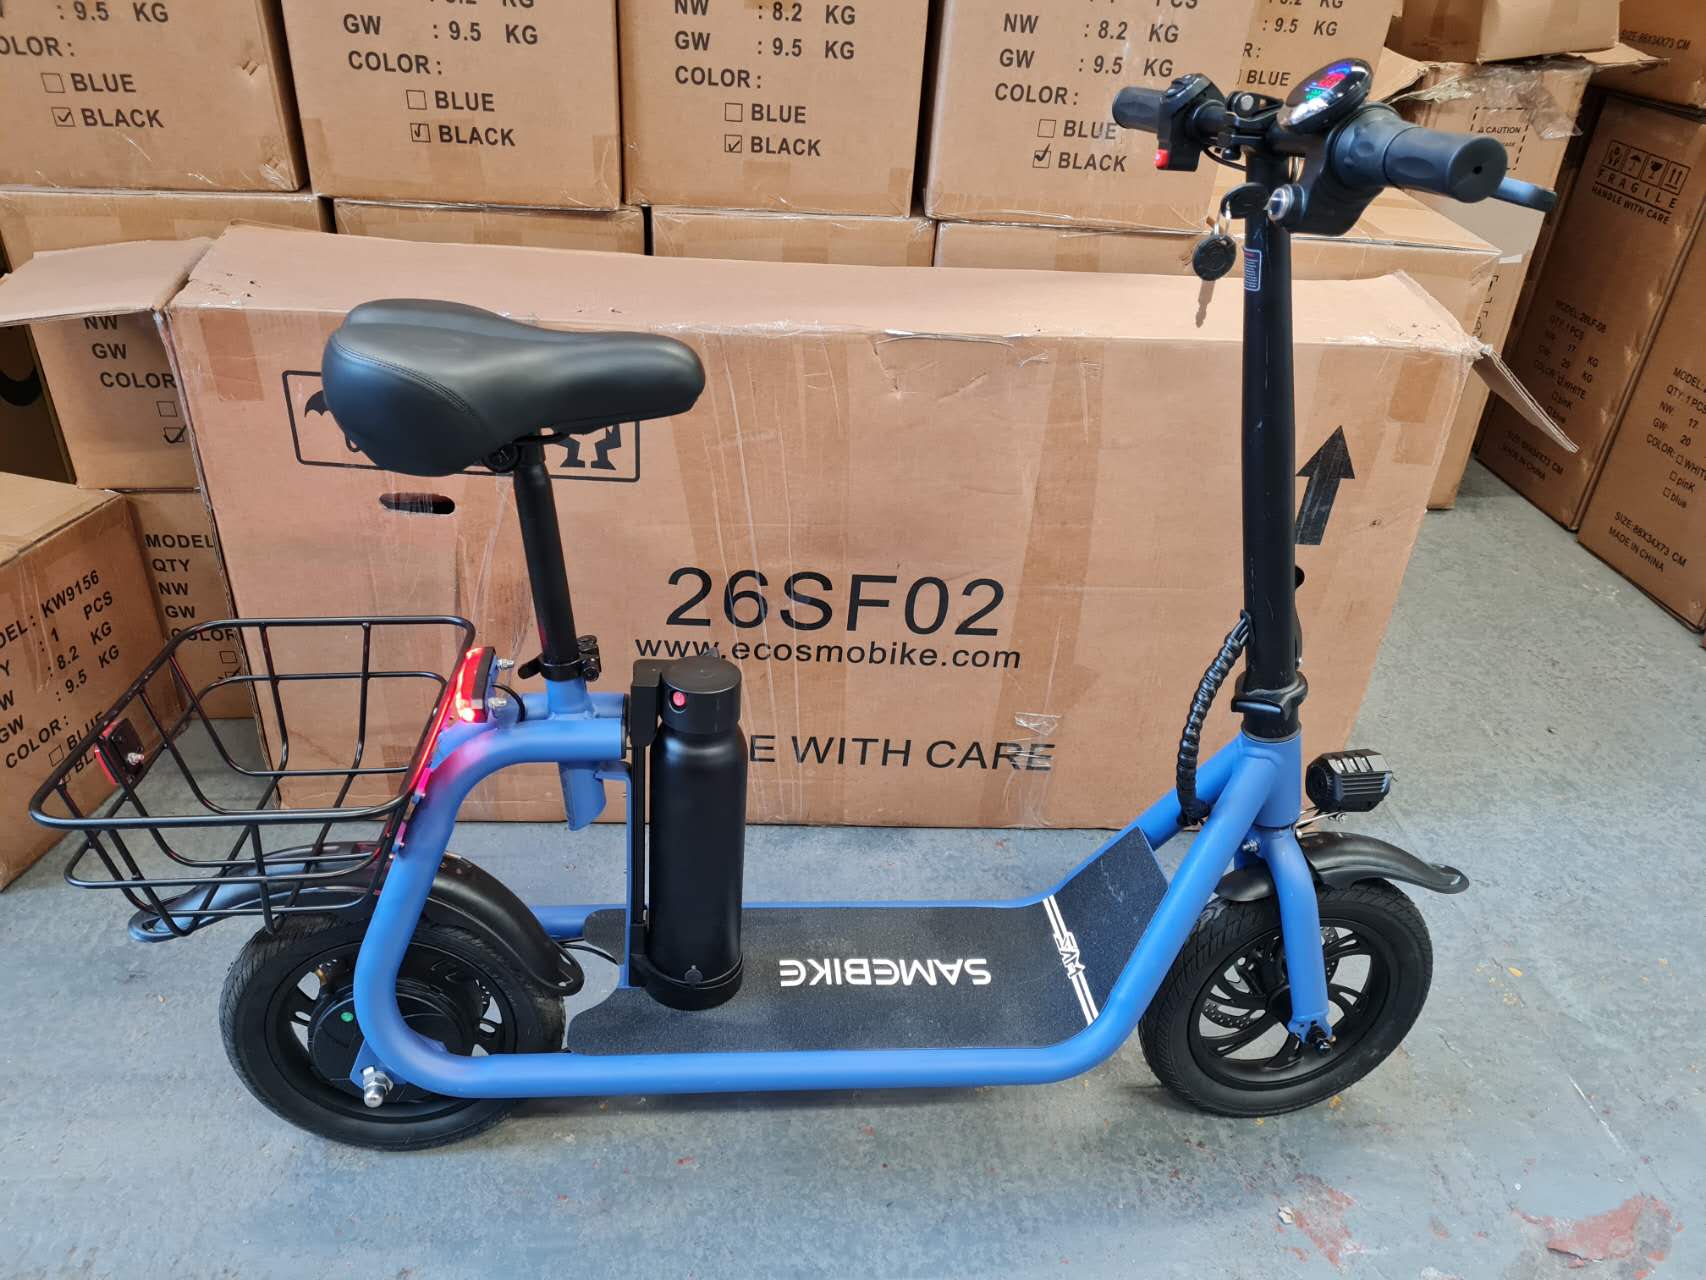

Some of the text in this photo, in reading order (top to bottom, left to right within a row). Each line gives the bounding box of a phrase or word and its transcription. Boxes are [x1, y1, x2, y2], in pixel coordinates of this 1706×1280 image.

[75, 2, 110, 21] 9.5
[134, 2, 169, 23] KG
[674, 0, 709, 16] NW
[772, 1, 802, 22] 8.2
[825, 4, 856, 25] KG
[343, 14, 381, 35] GW
[448, 20, 482, 41] 9.5
[505, 24, 538, 45] KG
[1003, 13, 1039, 34] NW
[1098, 20, 1128, 41] 8.2
[1148, 23, 1179, 43] KG
[1274, 17, 1298, 33] 9.5
[1313, 20, 1338, 36] KG
[674, 30, 711, 51] GW
[772, 37, 802, 57] 9.5
[825, 40, 855, 60] KG
[1000, 48, 1035, 69] GW
[1093, 55, 1123, 75] 9.5
[1143, 58, 1174, 78] KG
[70, 72, 136, 93] BLUE
[1246, 69, 1290, 86] BLUE
[434, 90, 495, 112] BLUE
[81, 107, 164, 129] BLACK
[751, 103, 807, 124] BLUE
[438, 124, 516, 147] BLACK
[1063, 120, 1117, 140] BLUE
[1485, 126, 1521, 134] CAUTION
[750, 136, 821, 157] BLACK
[1058, 152, 1128, 172] BLACK
[1599, 169, 1678, 209] FRAGILE
[1592, 186, 1671, 225] HANDLE WITH CARE
[83, 315, 118, 330] NW
[92, 343, 127, 360] GW
[100, 372, 177, 389] COLOR
[1688, 417, 1699, 430] 17
[1680, 434, 1691, 447] 20
[1684, 458, 1706, 482] WHIT
[145, 534, 214, 549] MODEL
[1608, 526, 1631, 547] MADE
[1639, 549, 1664, 572] CHINA
[152, 559, 190, 573] QTY
[1671, 552, 1688, 568] CM
[41, 570, 100, 619] KW9156
[159, 583, 189, 596] NW
[165, 605, 195, 619] GW
[666, 566, 1005, 637] 26SF02
[51, 628, 59, 642] 1
[83, 591, 113, 620] PCS
[57, 645, 80, 670] 8.2
[90, 621, 113, 645] KG
[635, 639, 1021, 669] www.ecosmobike.com
[65, 669, 87, 694] 9.5
[98, 645, 120, 668] KG
[792, 735, 912, 767] WITH
[926, 740, 1056, 771] CARE
[779, 958, 992, 987] SAMEBIKE
